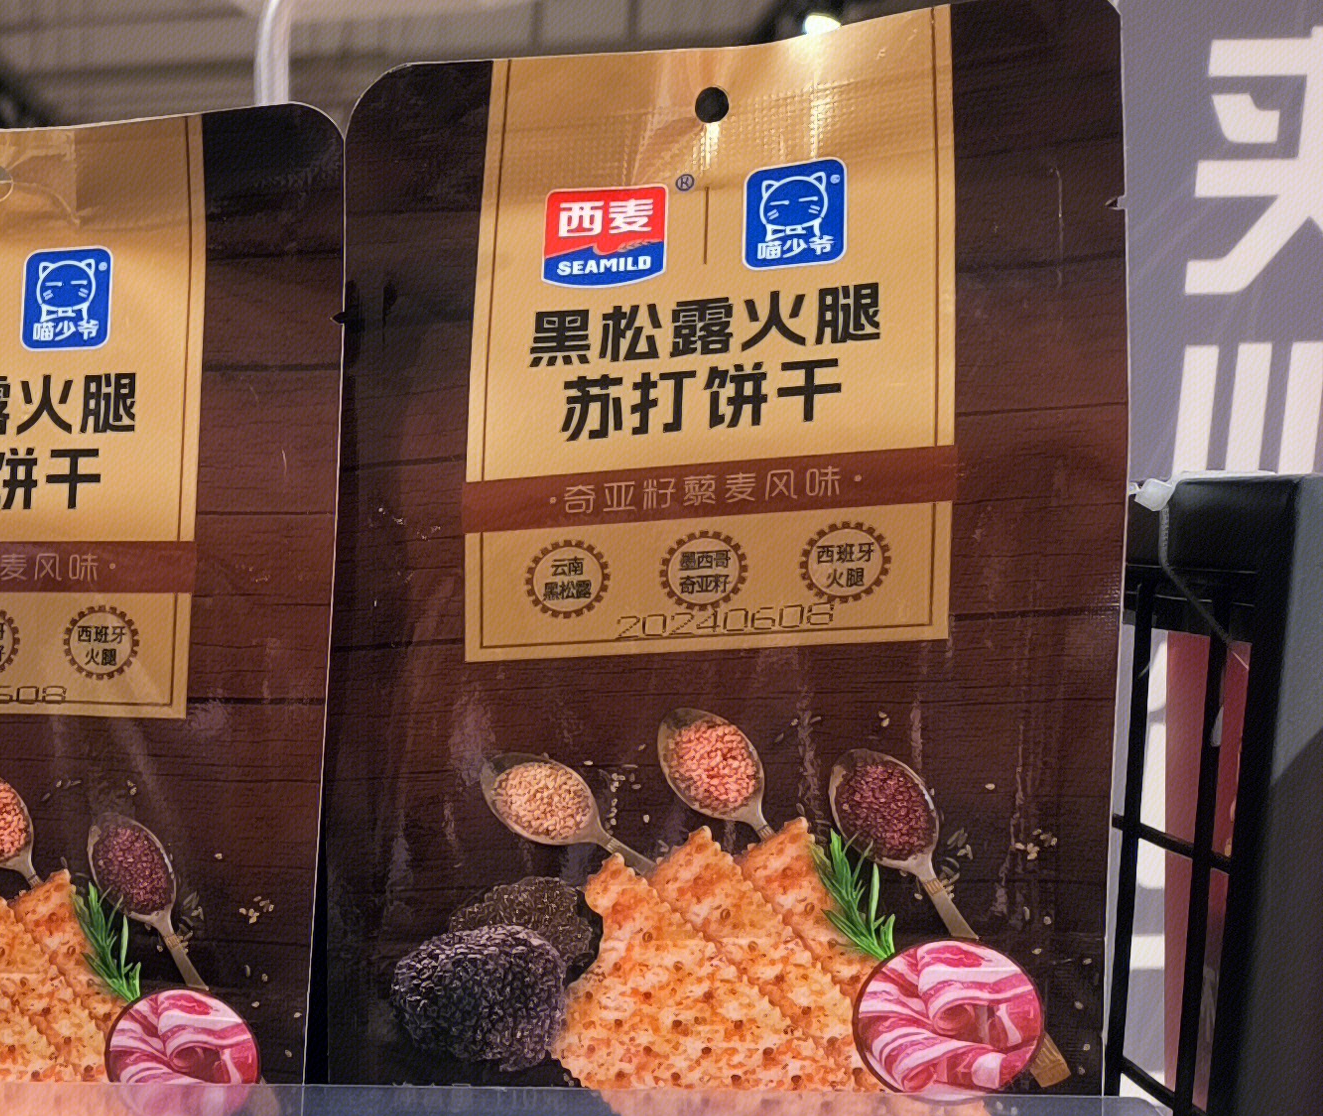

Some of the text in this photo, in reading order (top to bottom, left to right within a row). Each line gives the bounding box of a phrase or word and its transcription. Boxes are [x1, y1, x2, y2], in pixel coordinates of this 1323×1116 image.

[558, 199, 654, 238] 西麦
[757, 235, 834, 260] 喵少爷
[557, 256, 652, 276] SEAMILD
[33, 320, 99, 342] 喵少爷
[529, 282, 882, 368] 黑松露火腿
[561, 358, 842, 442] 苏打饼干
[563, 466, 842, 514] 奇亚籽藜麦风味
[680, 549, 731, 571] 墨西哥
[817, 543, 875, 564] 西班牙
[551, 556, 584, 577] 云南
[826, 567, 865, 589] 火腿
[543, 580, 592, 600] 黑松露
[615, 602, 833, 641] 20240608
[77, 625, 127, 644] 西班牙
[84, 647, 117, 667] 火腿
